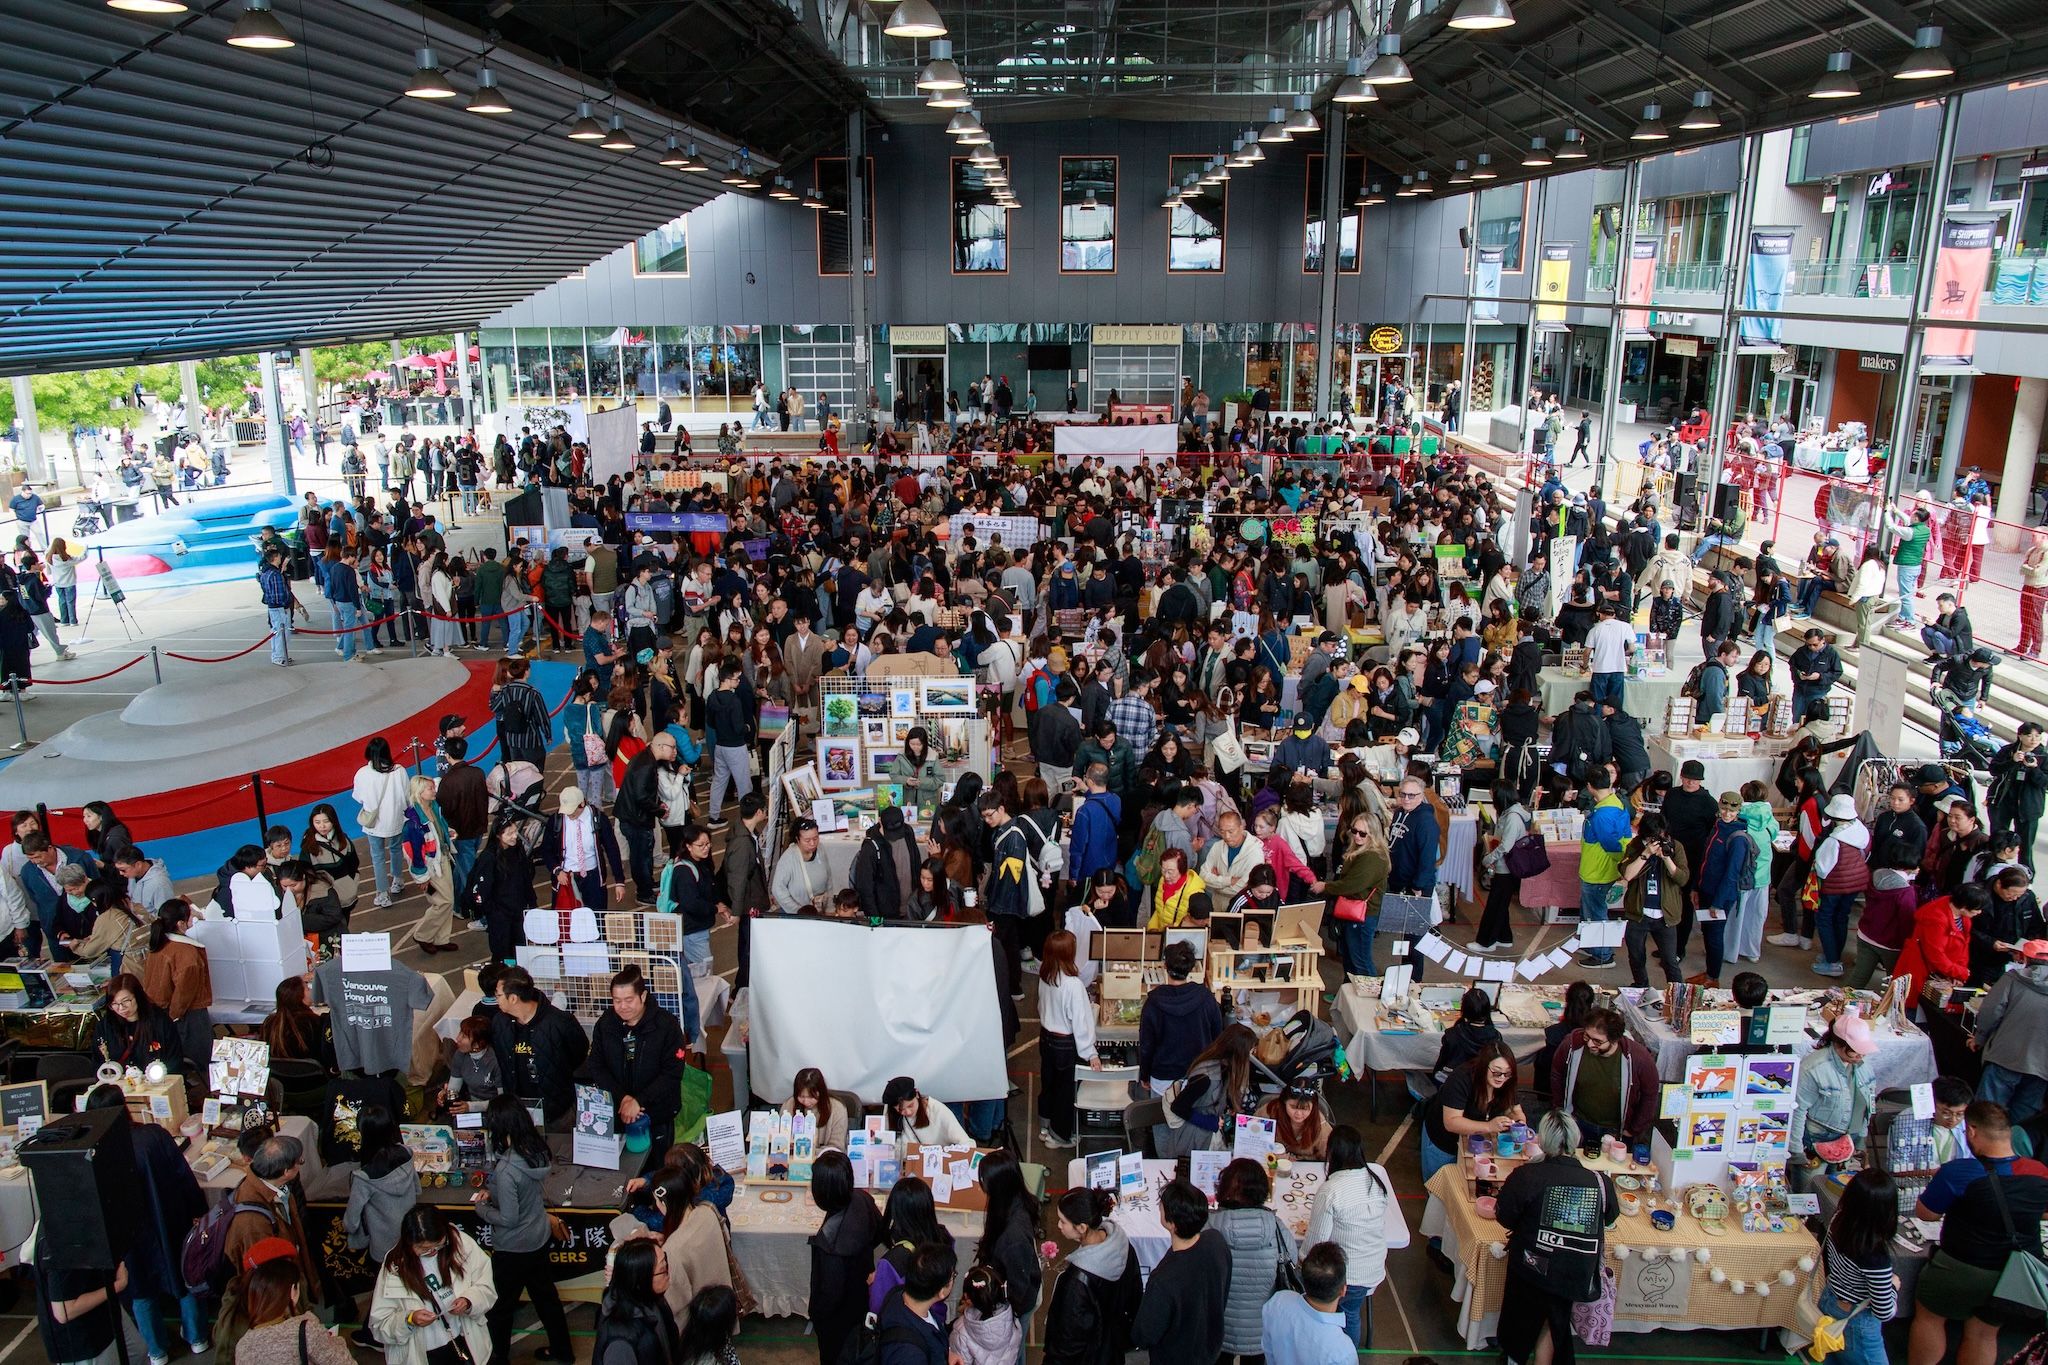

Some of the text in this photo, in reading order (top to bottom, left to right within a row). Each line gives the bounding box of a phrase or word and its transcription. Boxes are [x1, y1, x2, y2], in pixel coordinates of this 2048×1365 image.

[1955, 239, 1988, 247] COMMONS
[893, 331, 942, 342] WASHROOMS
[1098, 329, 1177, 341] SUPPLY SHOP
[1861, 354, 1897, 371] makers
[1553, 539, 1575, 549] Fortune
[342, 981, 388, 992] Vancouver
[344, 992, 388, 1004] Hong Kong
[10, 1091, 32, 1100] WELCOME
[25, 1105, 39, 1113] LIGHT
[1541, 1232, 1565, 1247] HCA
[1624, 1302, 1656, 1310] Messymal
